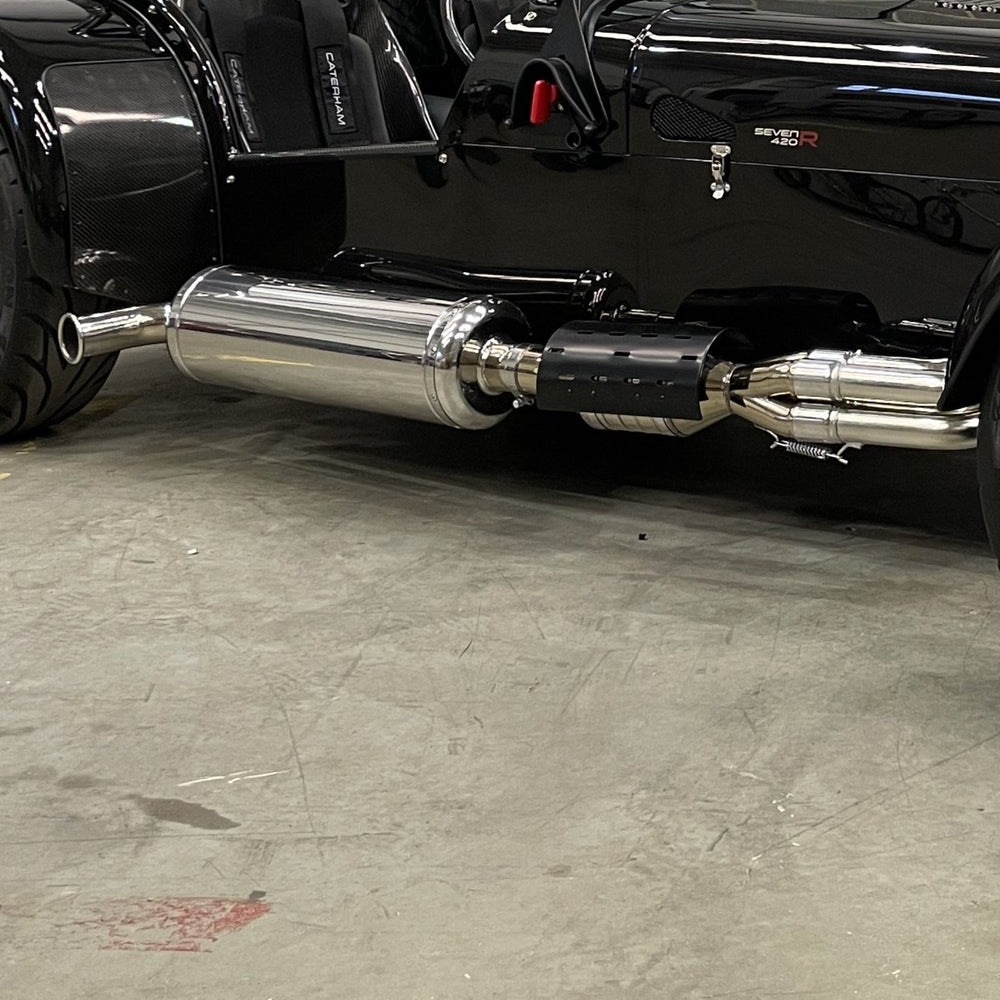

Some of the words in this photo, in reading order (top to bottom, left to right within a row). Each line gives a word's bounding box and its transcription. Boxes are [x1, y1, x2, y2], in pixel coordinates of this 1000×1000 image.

[325, 52, 346, 126] CATERHAM
[754, 128, 799, 138] SEVEN
[770, 137, 798, 146] 420
